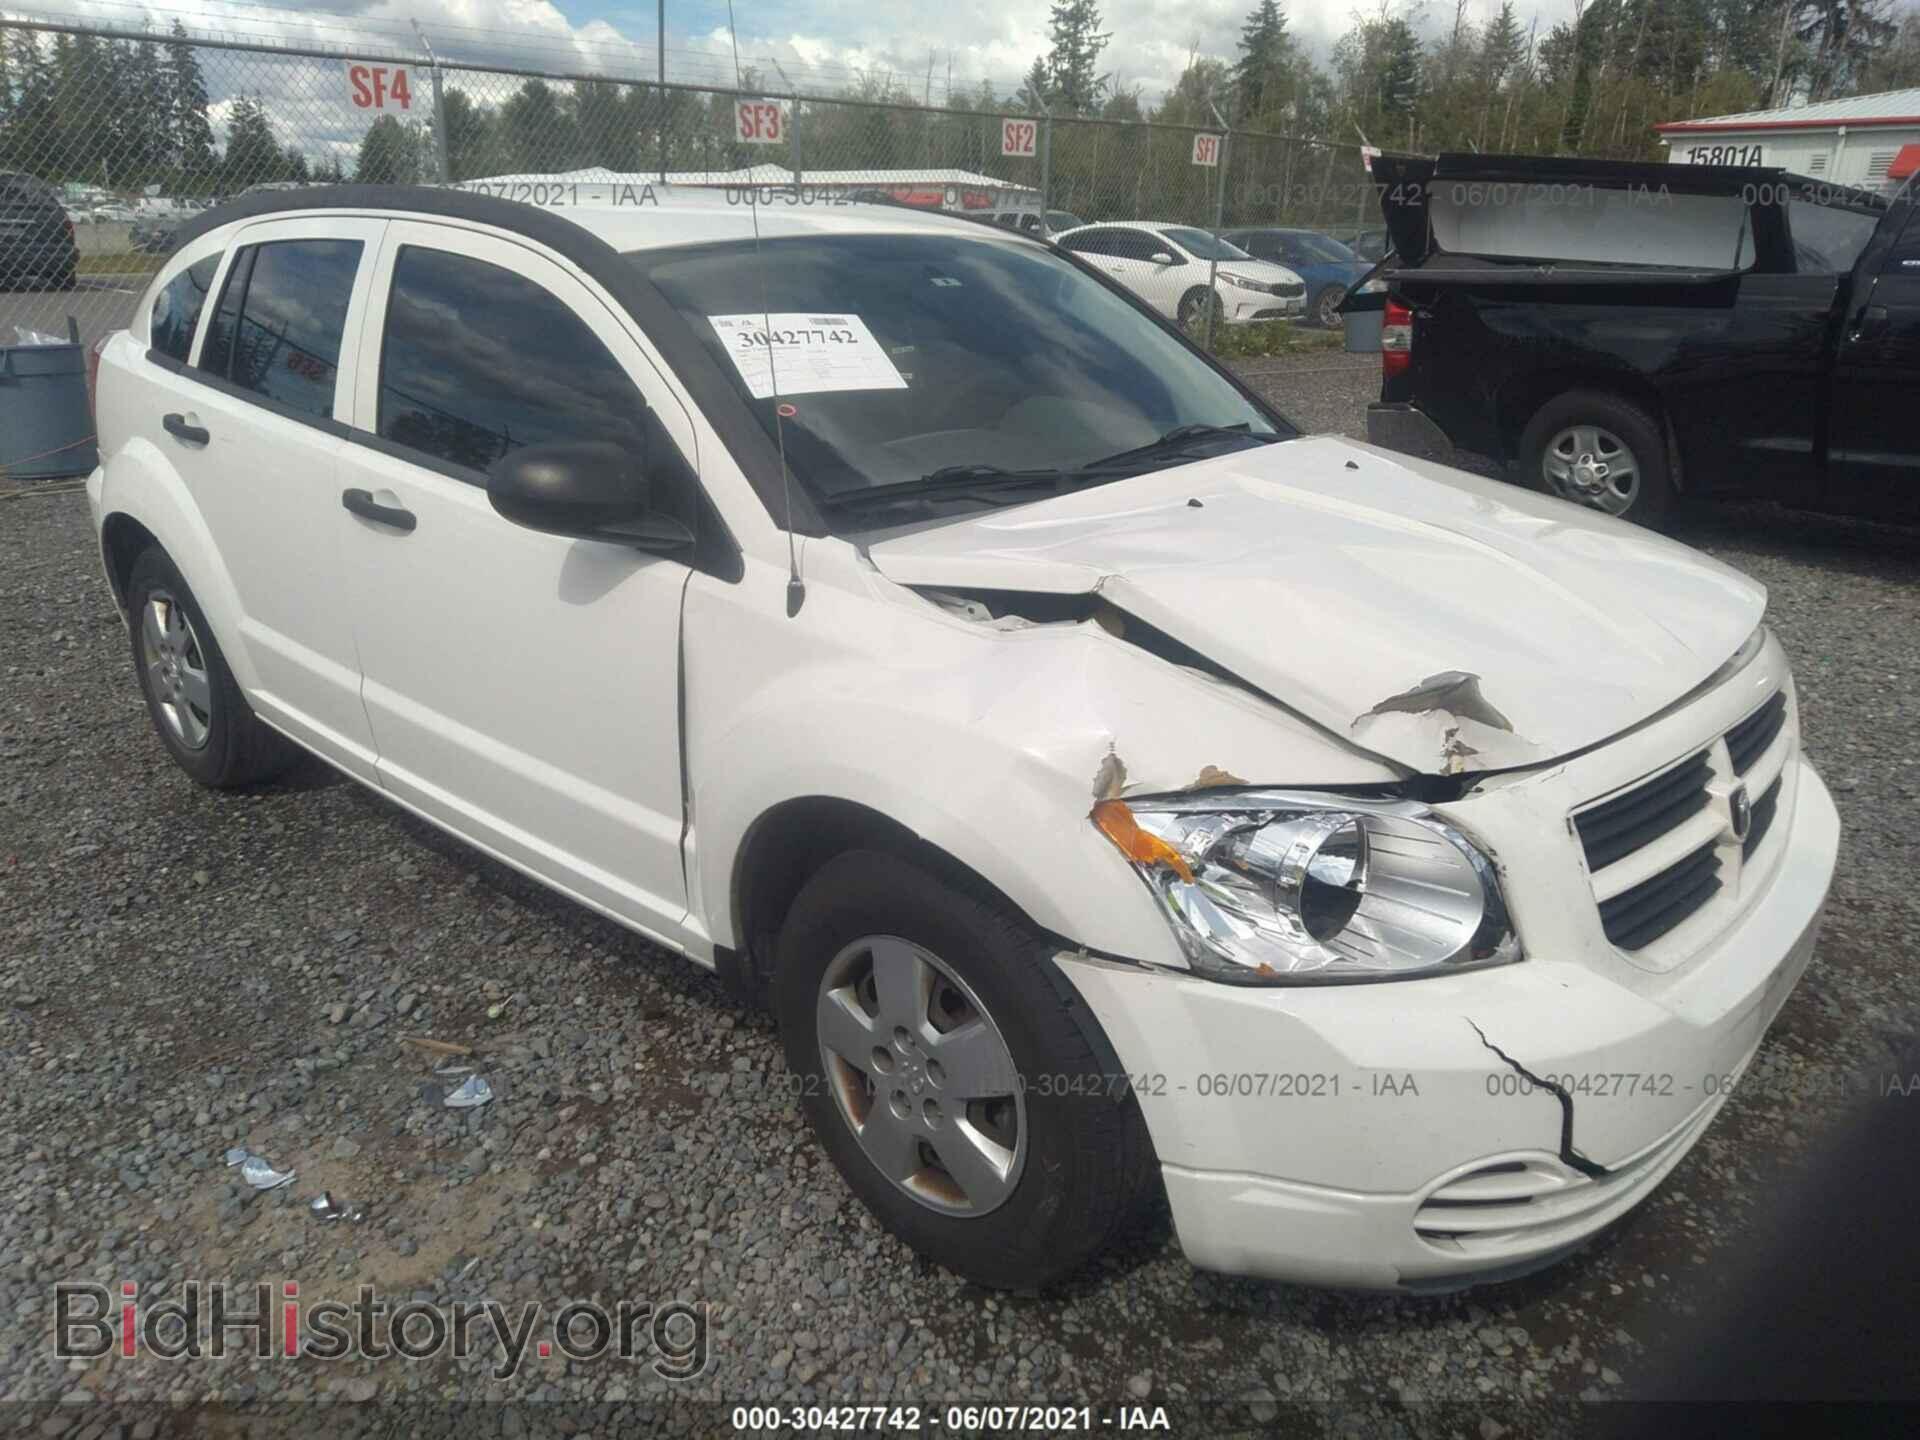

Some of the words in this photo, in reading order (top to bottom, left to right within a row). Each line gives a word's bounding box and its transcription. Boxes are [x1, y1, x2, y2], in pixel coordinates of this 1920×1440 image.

[350, 65, 411, 110] SF4
[739, 104, 778, 139] SF3
[1005, 123, 1034, 153] SF2
[1196, 137, 1216, 163] SF1
[1687, 144, 1762, 167] 15801A
[736, 329, 859, 348] 30427742
